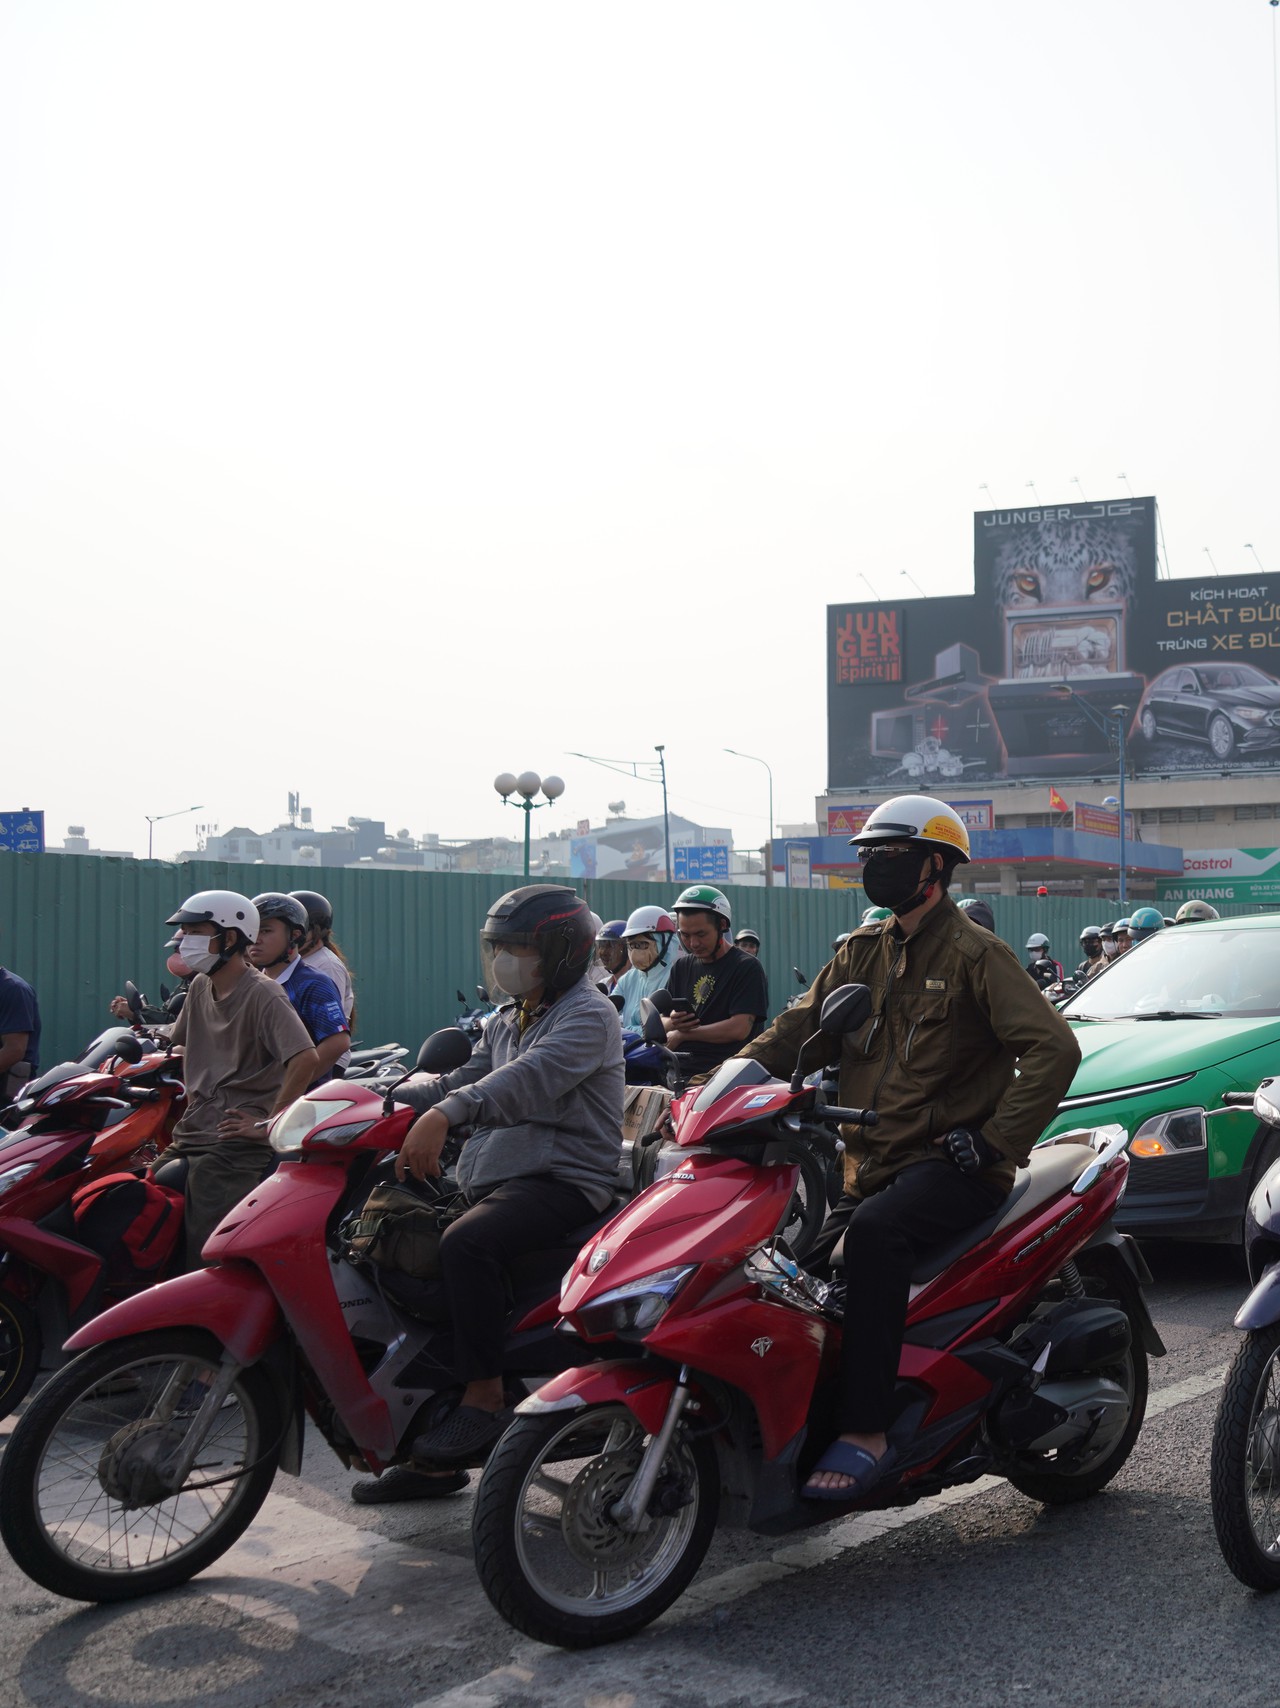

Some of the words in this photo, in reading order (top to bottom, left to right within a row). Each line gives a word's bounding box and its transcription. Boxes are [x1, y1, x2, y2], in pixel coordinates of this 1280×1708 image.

[984, 508, 1071, 527] JUNGER
[1190, 588, 1224, 601] KÍCH
[1228, 587, 1268, 600] HOẠT
[836, 611, 896, 636] JUN
[836, 633, 900, 657] GER
[1156, 637, 1207, 651] TRÚNG
[1212, 634, 1243, 650] XE
[841, 662, 884, 684] spirit
[1183, 857, 1233, 871] Castrol
[1164, 889, 1183, 901] AN
[1187, 887, 1235, 900] KHANG
[338, 1297, 374, 1310] ONDA
